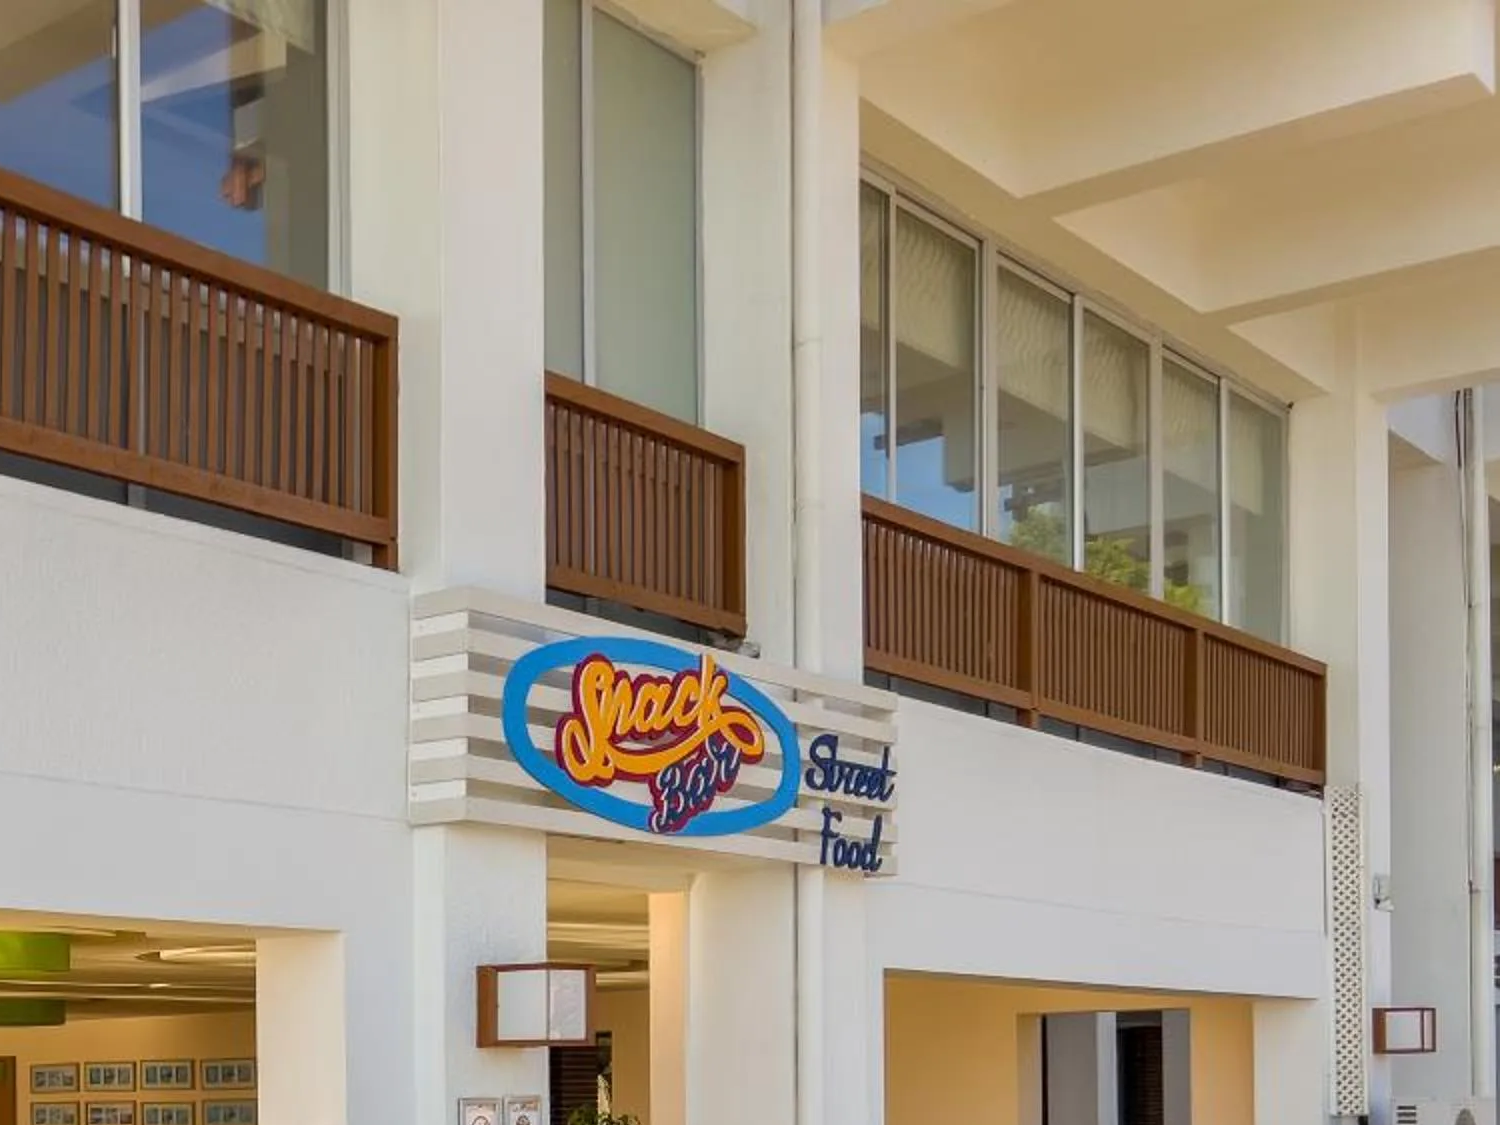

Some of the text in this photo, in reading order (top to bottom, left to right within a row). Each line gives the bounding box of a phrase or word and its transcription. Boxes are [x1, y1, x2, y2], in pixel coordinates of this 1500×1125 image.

[558, 654, 764, 784] Snack
[651, 732, 741, 833] Bar
[805, 733, 897, 803] Street
[819, 806, 884, 873] Food
